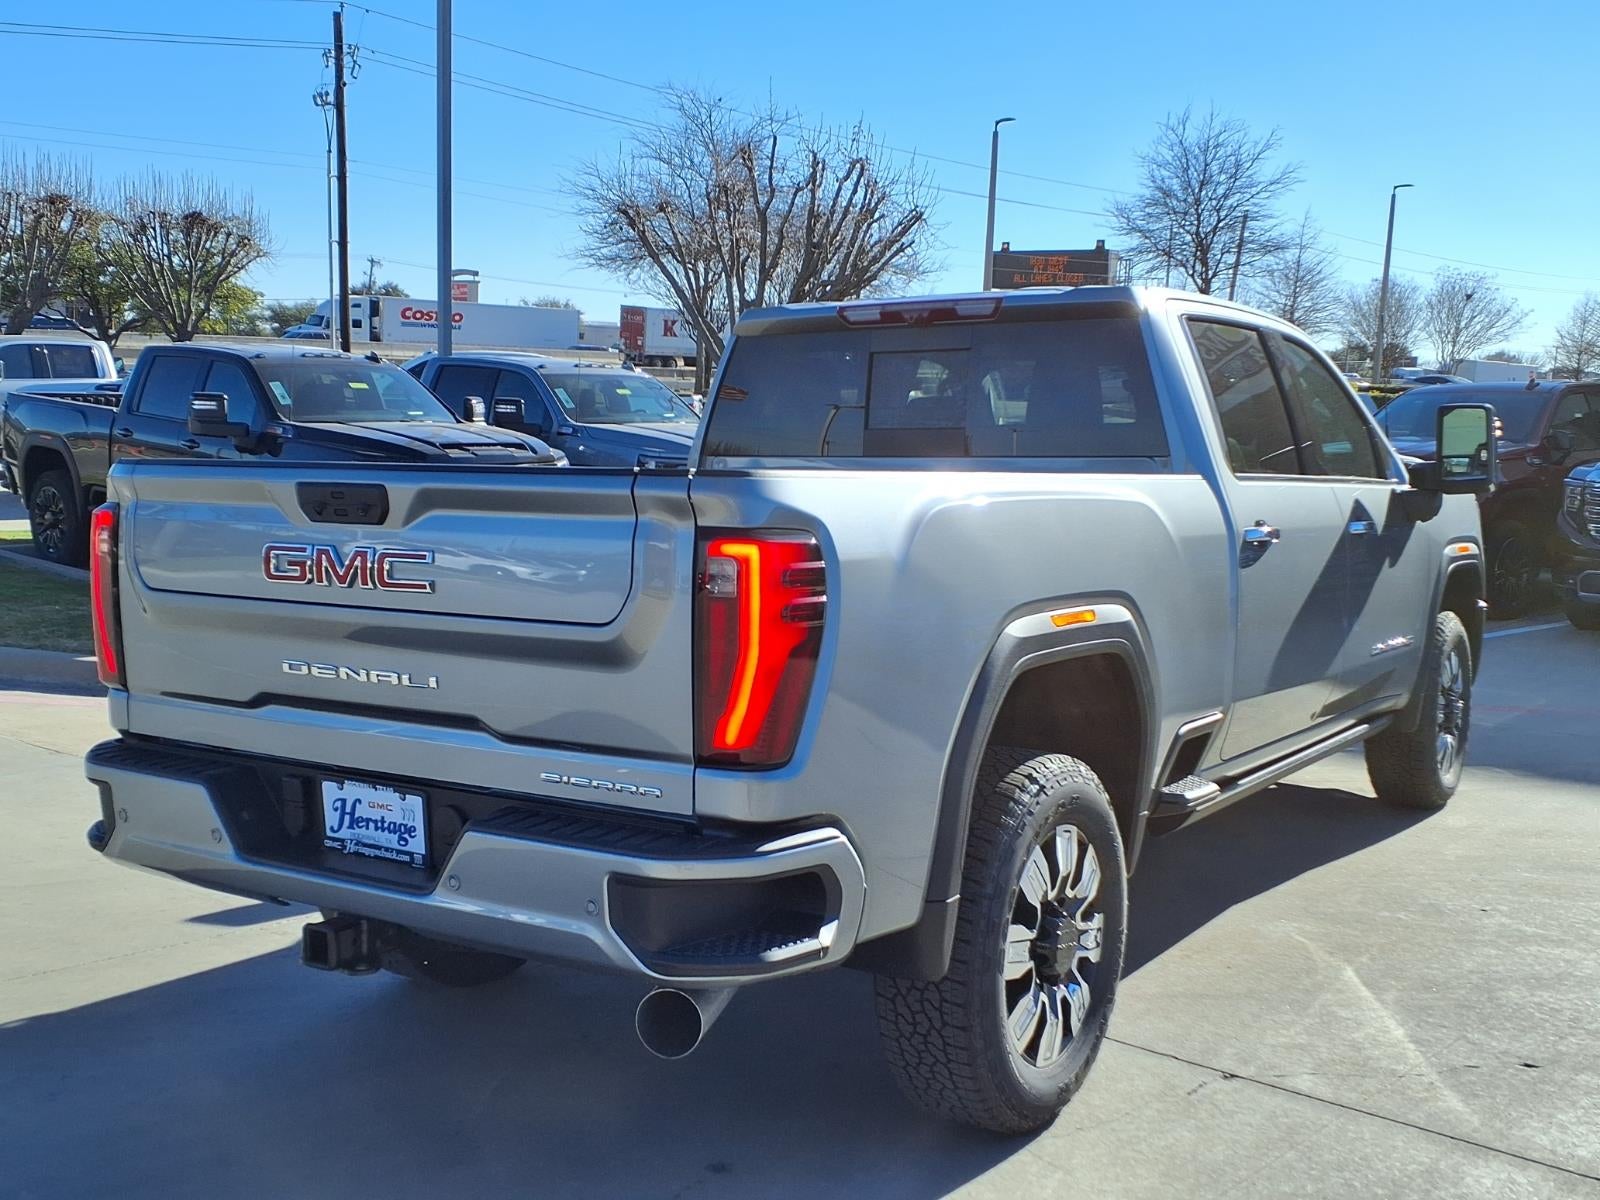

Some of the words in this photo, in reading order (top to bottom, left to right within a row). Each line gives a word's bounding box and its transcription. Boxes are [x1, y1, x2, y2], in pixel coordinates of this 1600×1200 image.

[1014, 274, 1027, 283] ALL
[1031, 274, 1054, 283] LANES
[1056, 273, 1084, 282] CLOSED
[400, 306, 464, 323] COSO
[263, 543, 435, 594] GMC
[282, 659, 439, 689] DENALI
[540, 772, 663, 798] SIERRA
[368, 801, 394, 812] GMC
[329, 798, 417, 847] Heritage
